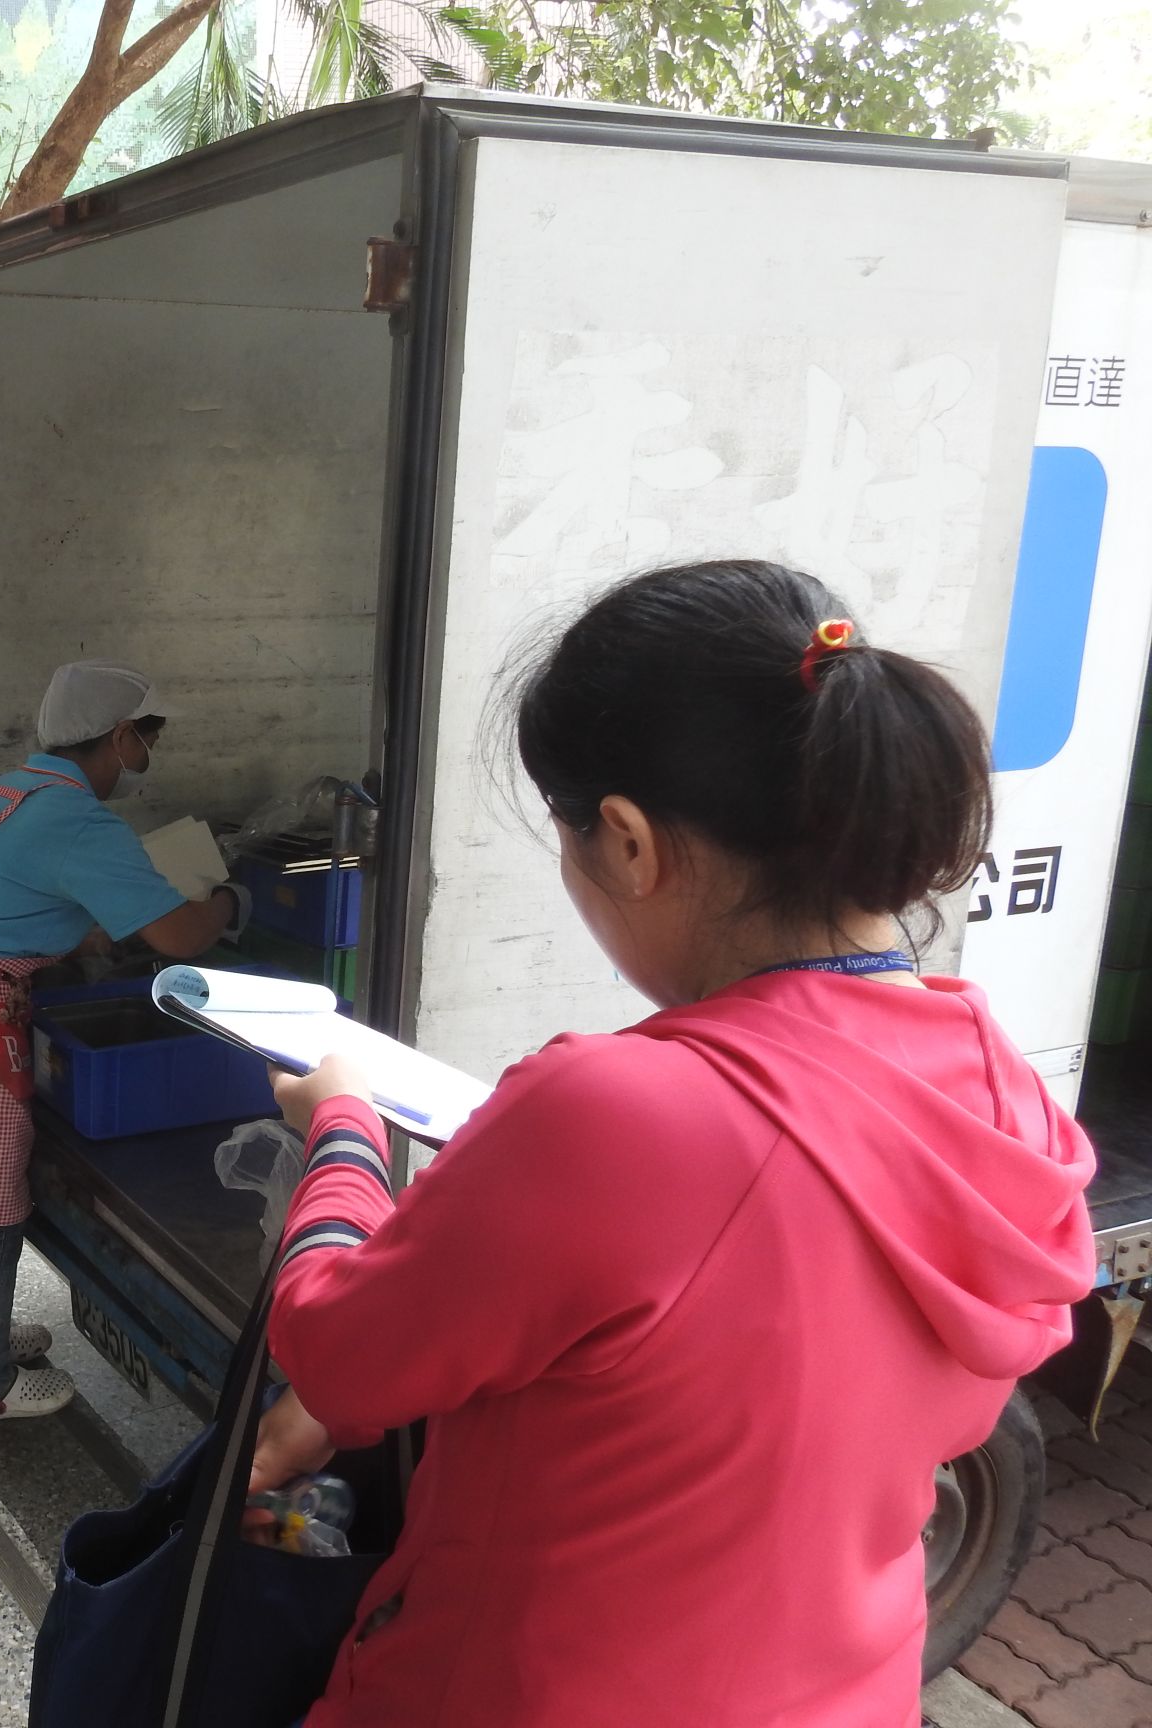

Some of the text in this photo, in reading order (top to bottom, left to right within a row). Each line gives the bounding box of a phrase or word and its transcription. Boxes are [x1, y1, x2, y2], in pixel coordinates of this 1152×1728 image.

[1045, 355, 1125, 407] 直達
[967, 846, 1062, 923] 公司
[846, 956, 887, 969] County
